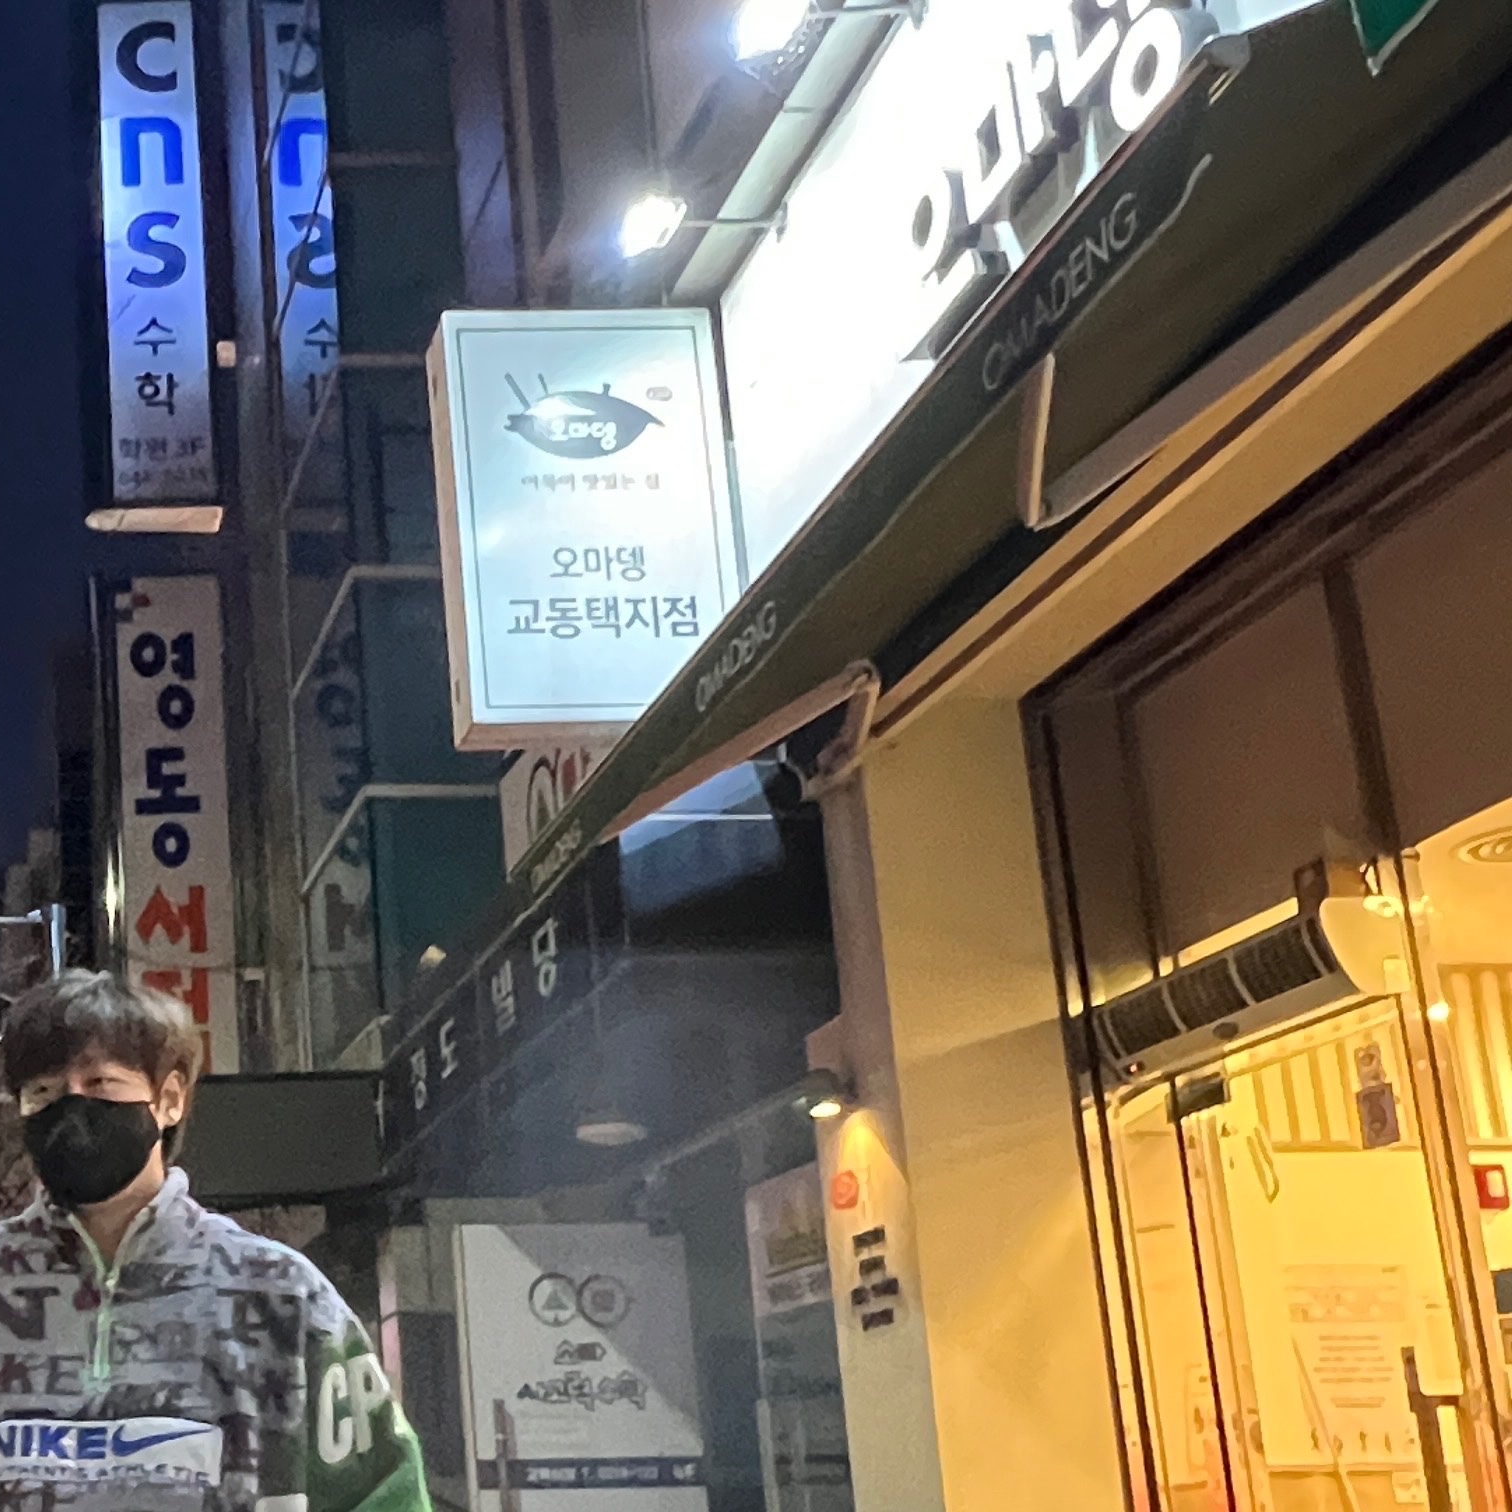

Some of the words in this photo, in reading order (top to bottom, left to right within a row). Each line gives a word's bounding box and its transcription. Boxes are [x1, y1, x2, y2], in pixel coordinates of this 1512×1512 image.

[982, 191, 1140, 392] OMADENG
[134, 317, 179, 416] 수학
[550, 420, 618, 451] 오마뎅
[550, 546, 646, 582] 오마뎅
[506, 595, 700, 640] 교동택지점
